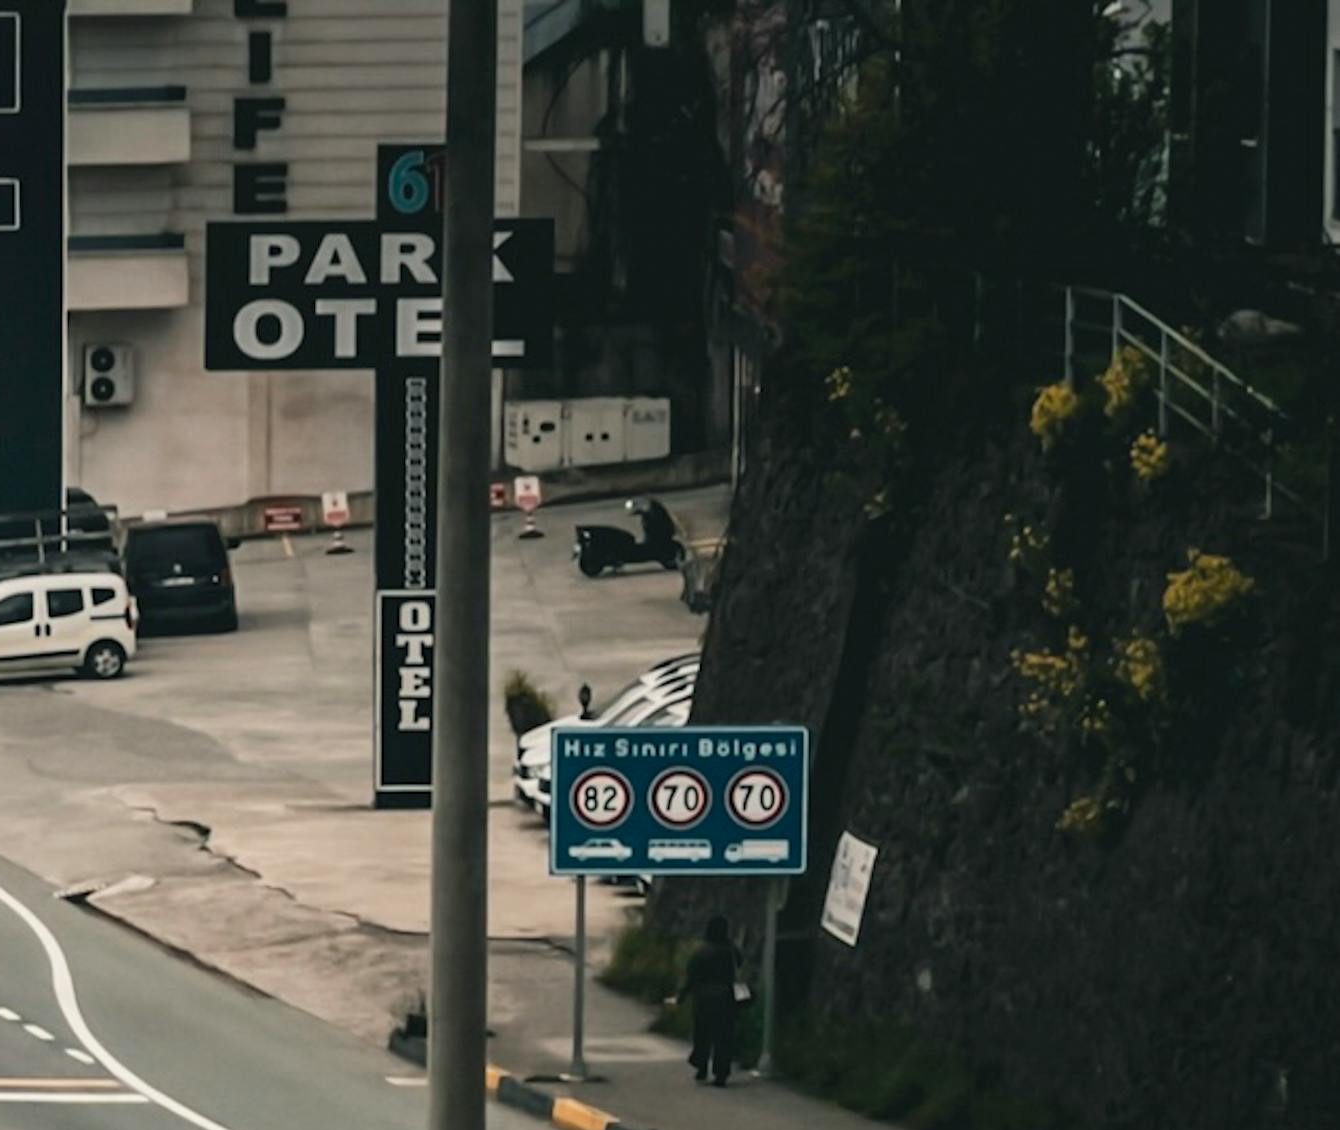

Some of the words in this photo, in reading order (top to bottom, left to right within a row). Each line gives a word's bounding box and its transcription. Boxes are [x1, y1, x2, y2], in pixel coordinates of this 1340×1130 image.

[394, 601, 434, 732] OTEL
[563, 738, 606, 758] Hız
[614, 738, 689, 758] Sınırı
[698, 737, 798, 761] Bölgesi
[584, 787, 618, 812] 82
[664, 786, 699, 812] 70
[740, 785, 775, 811] 70
